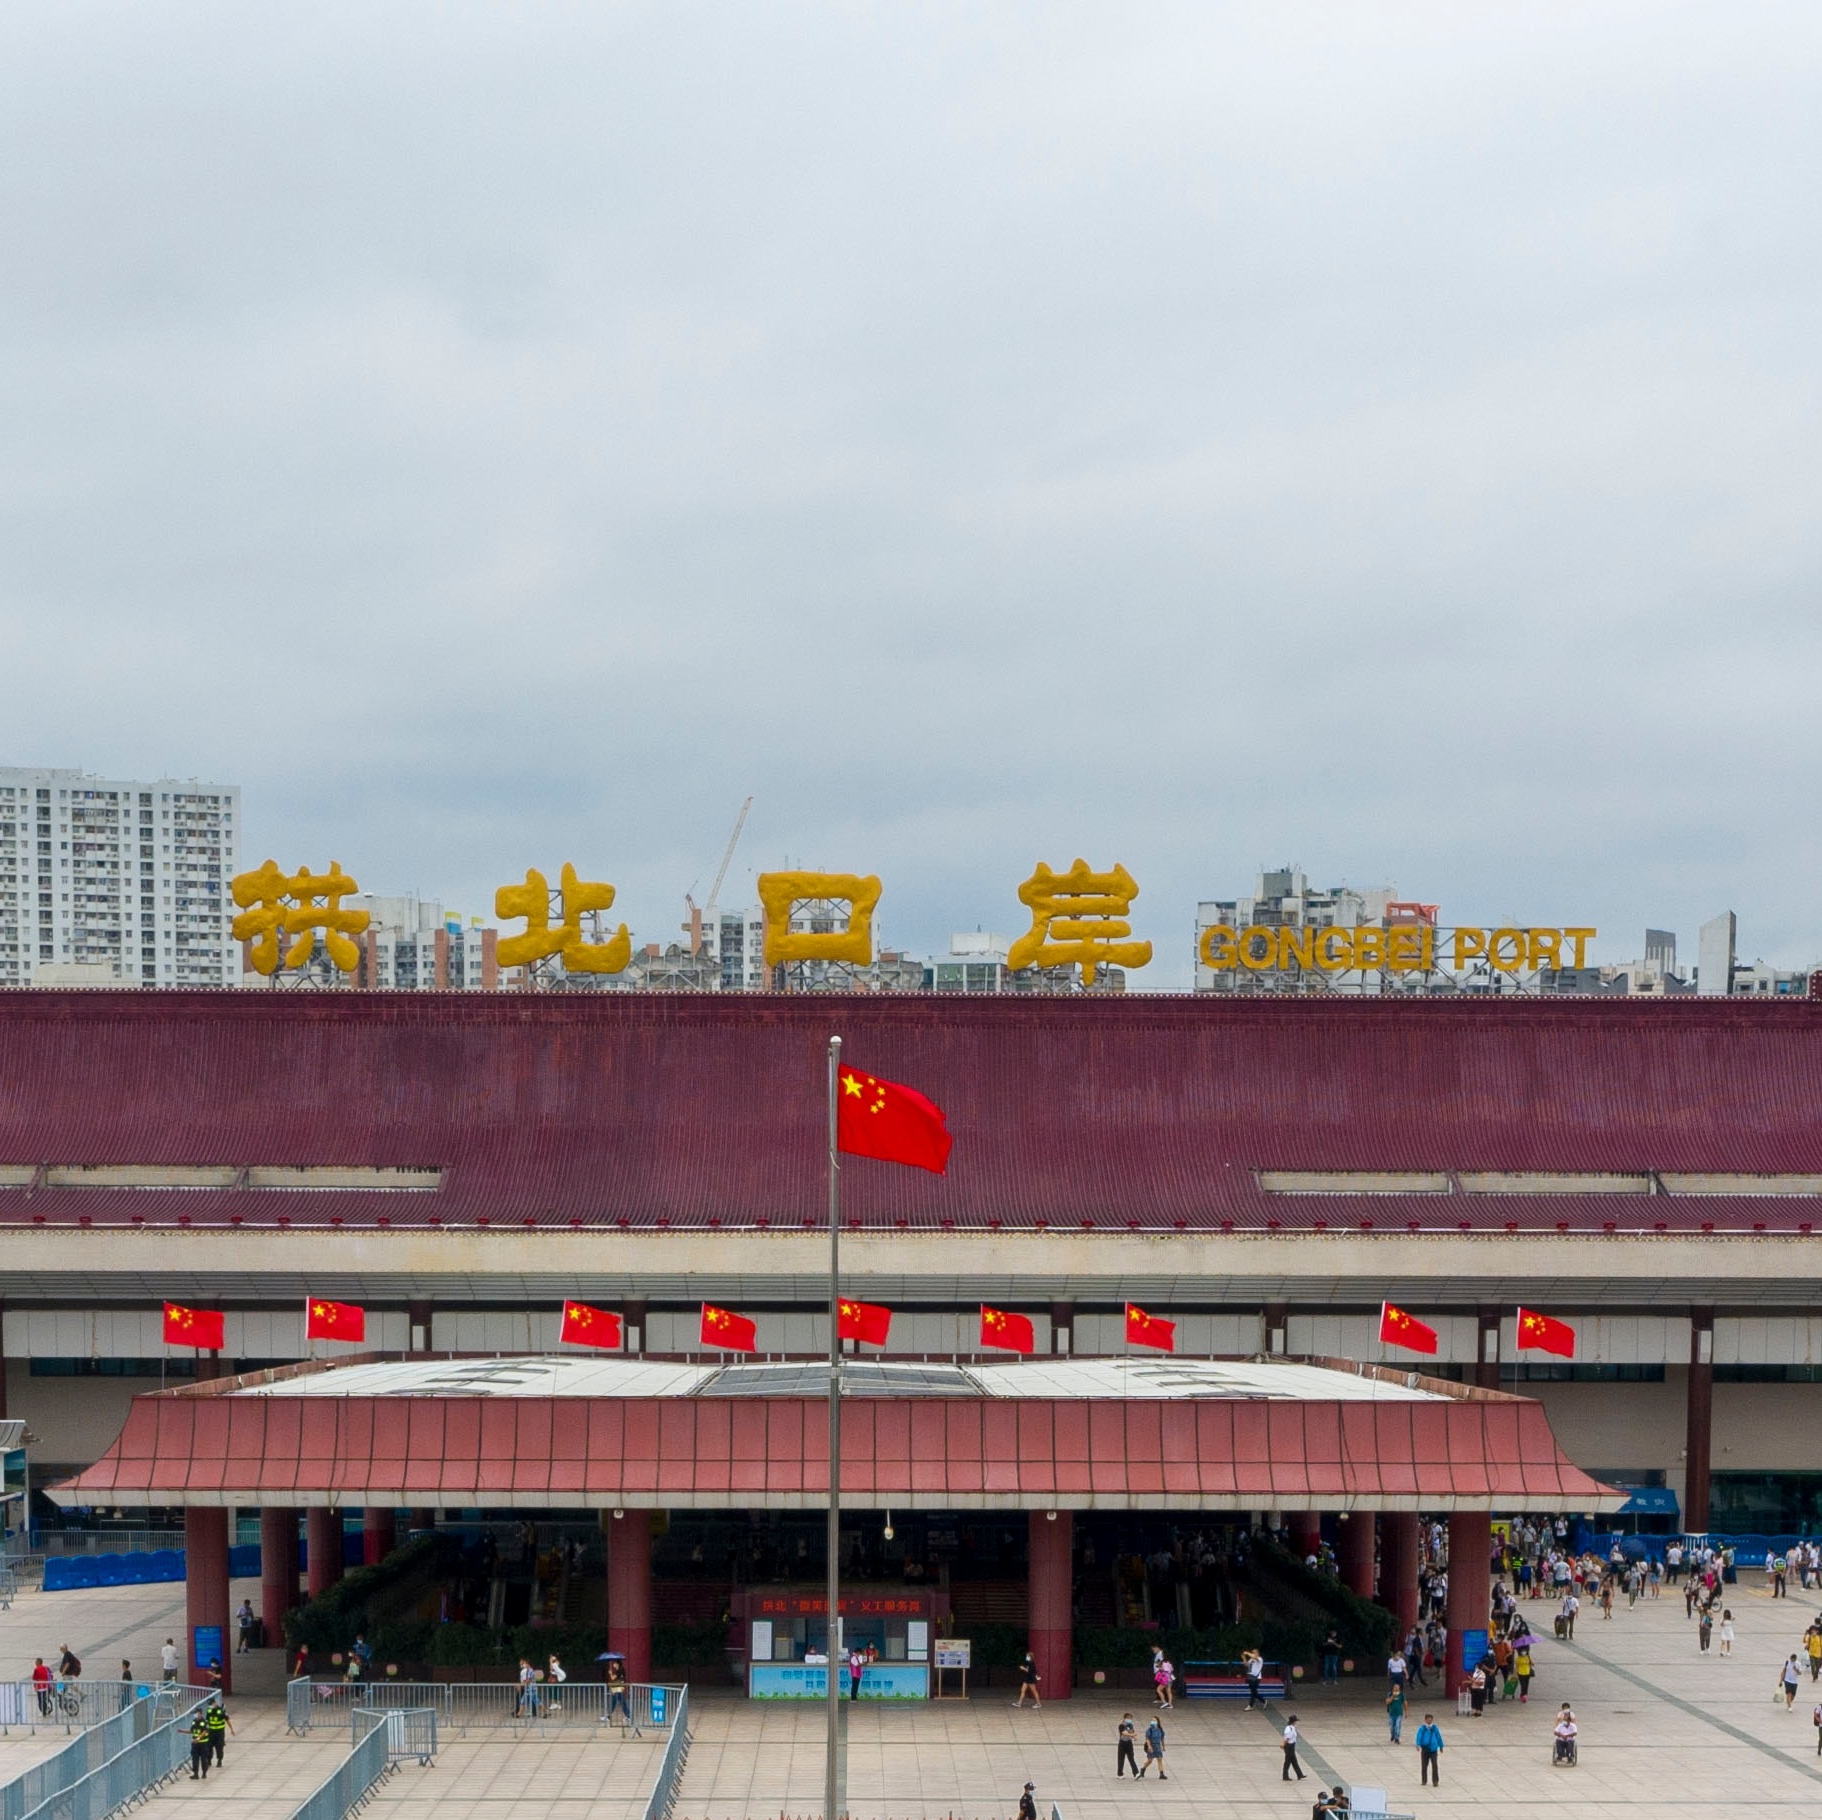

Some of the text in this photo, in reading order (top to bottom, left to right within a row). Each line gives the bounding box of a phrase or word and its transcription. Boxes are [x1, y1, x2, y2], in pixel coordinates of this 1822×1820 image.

[229, 857, 1153, 990] 拱北口岸
[1198, 925, 1597, 971] GONGBEI PORT
